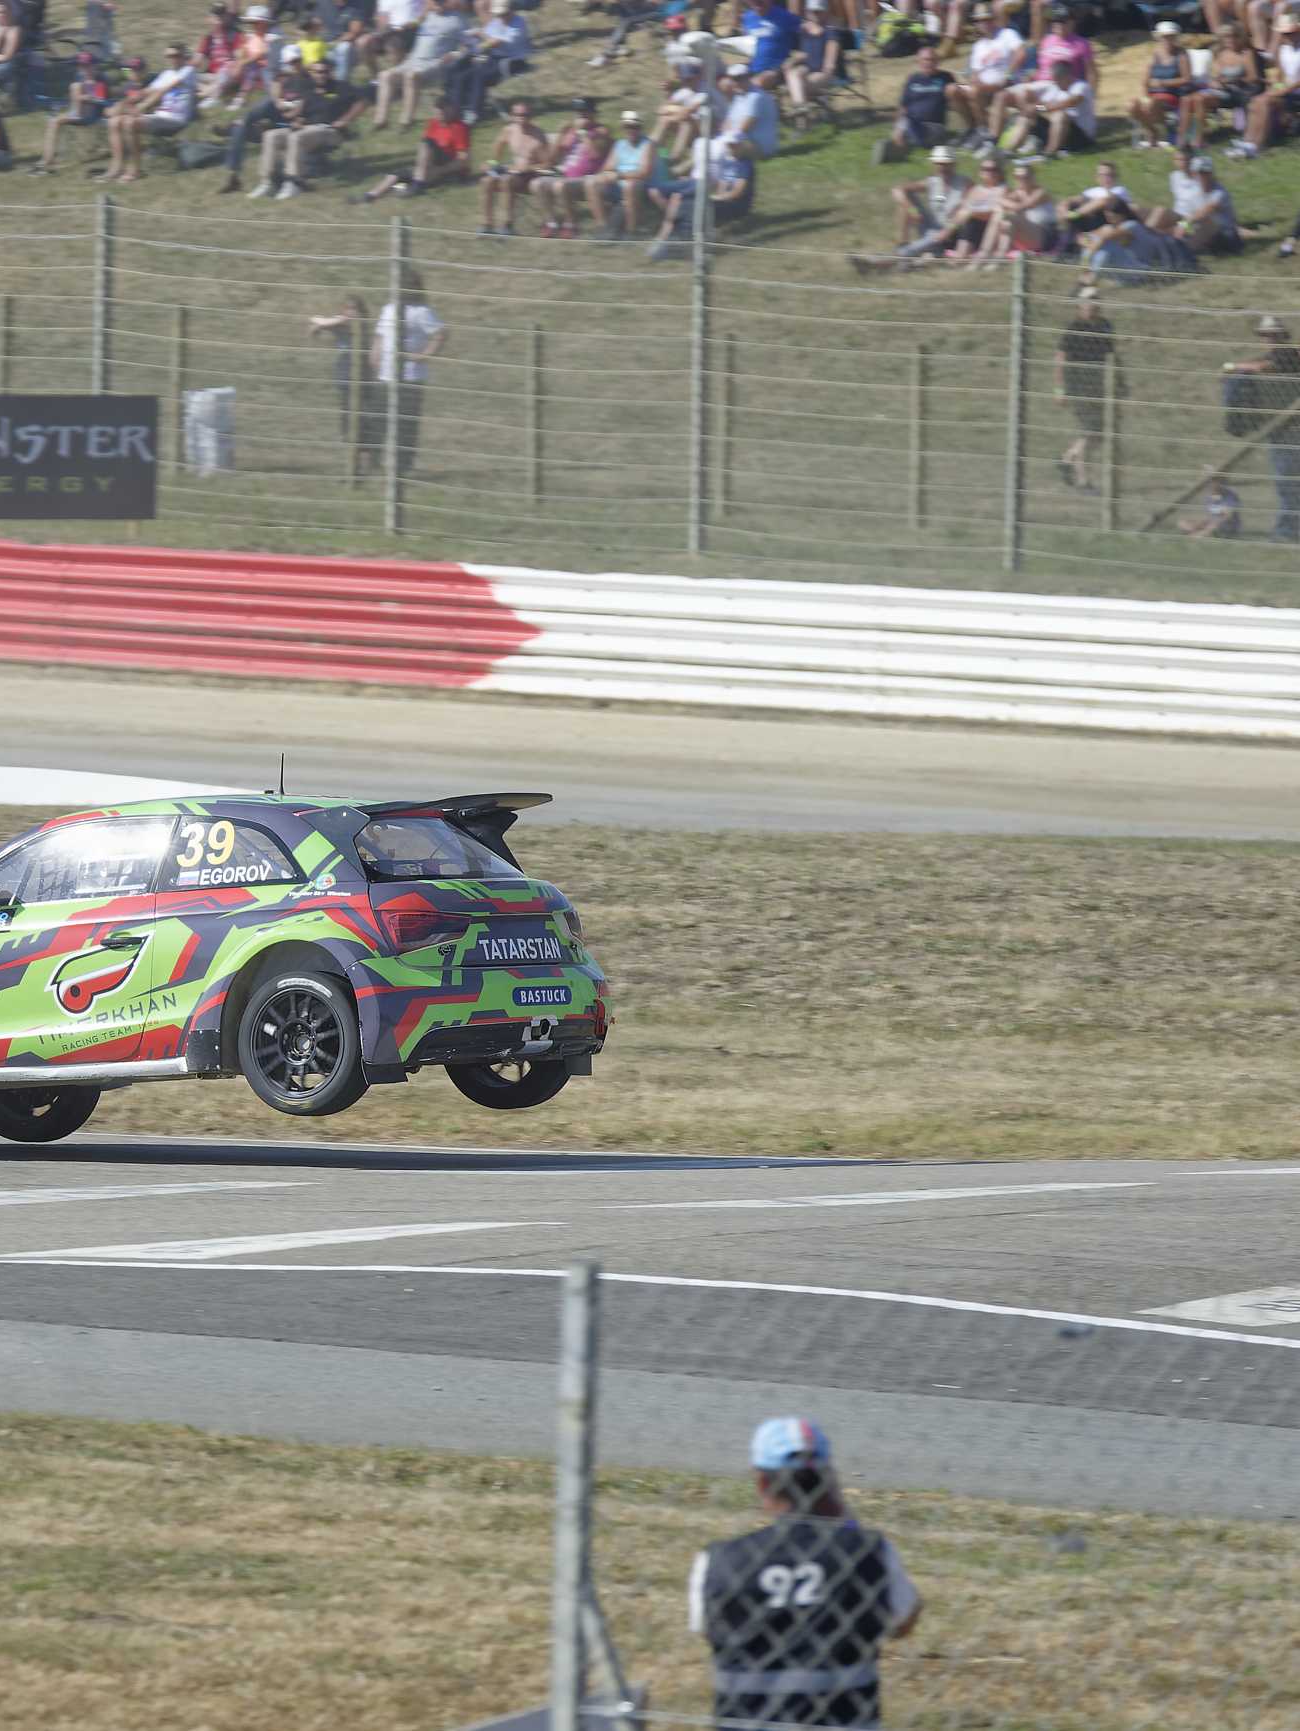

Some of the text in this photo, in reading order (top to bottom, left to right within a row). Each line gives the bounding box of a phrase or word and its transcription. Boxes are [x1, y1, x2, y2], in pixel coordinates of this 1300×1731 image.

[176, 820, 236, 867] 39
[199, 865, 271, 886] EGOROV
[479, 938, 562, 960] TATARSTAN
[520, 989, 567, 1003] BASTUCK
[61, 1026, 132, 1052] RACING TEAM
[759, 1562, 824, 1608] 92
